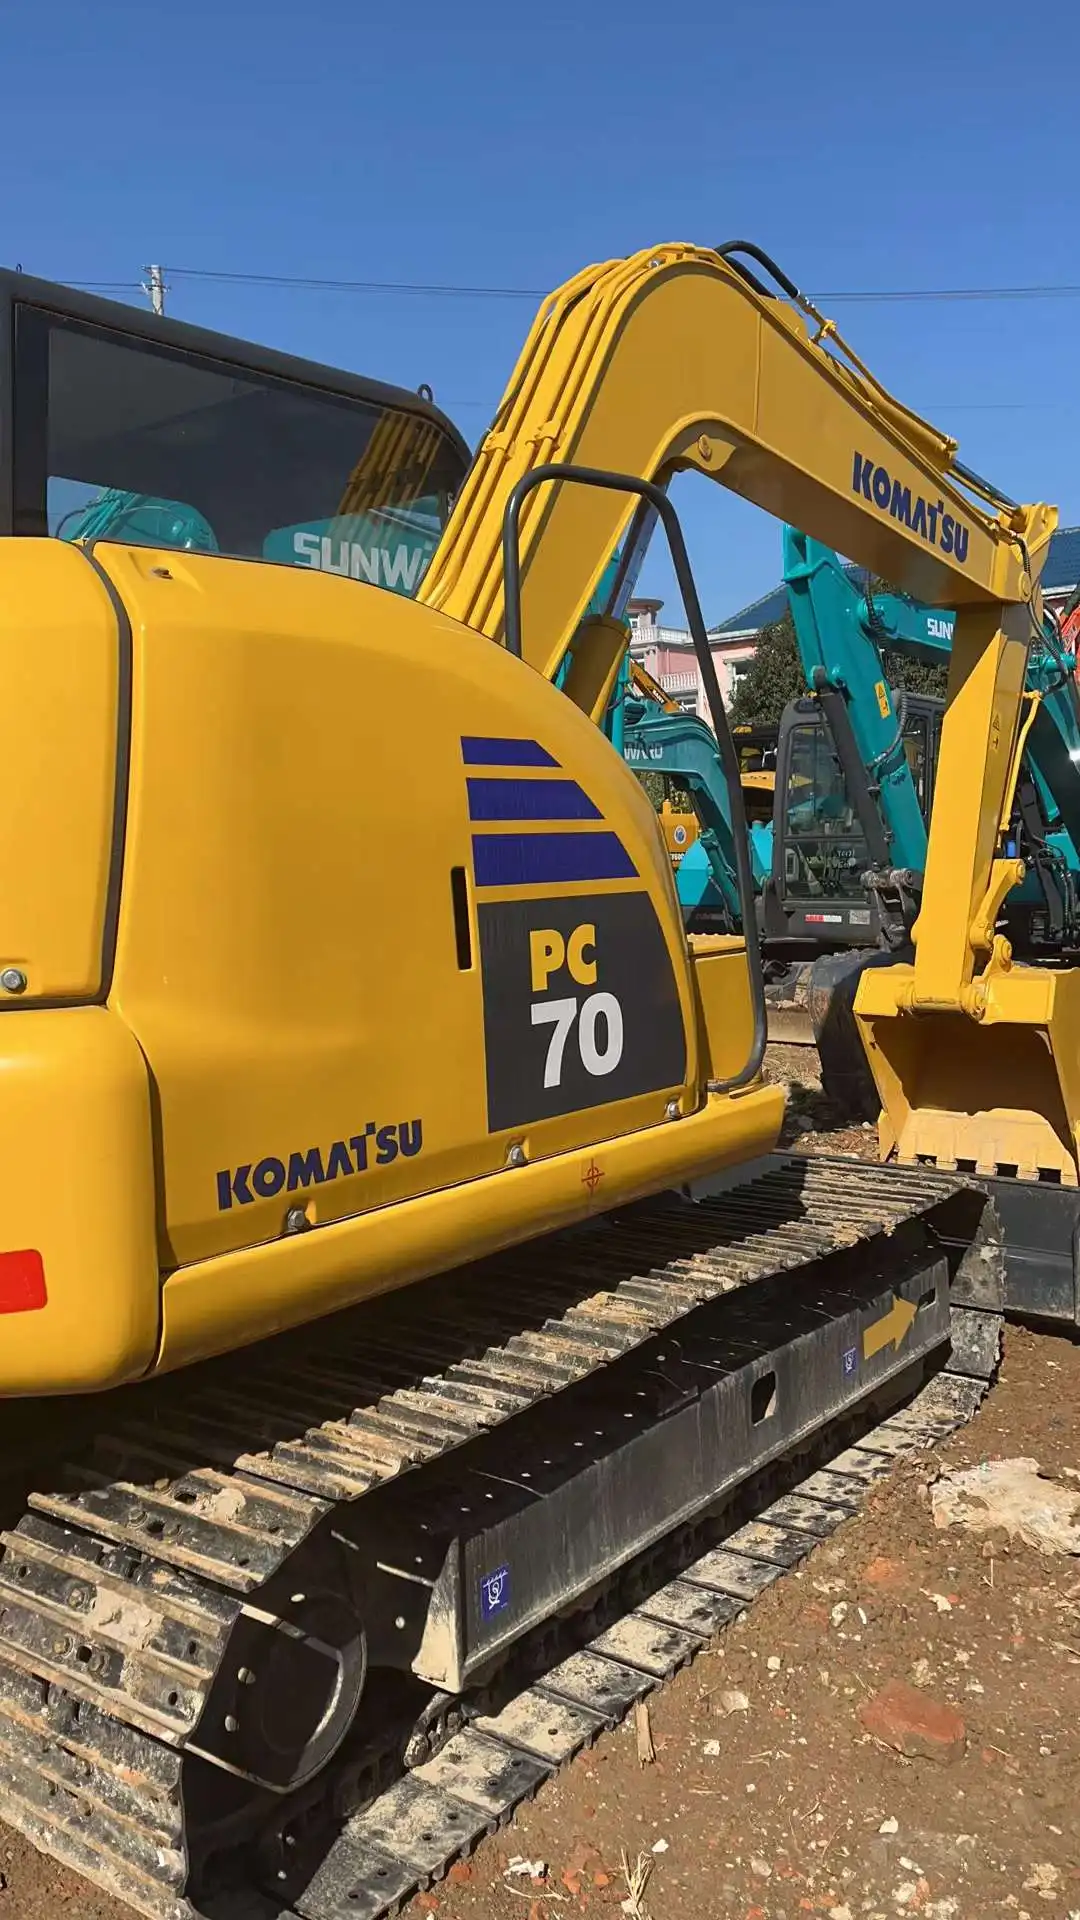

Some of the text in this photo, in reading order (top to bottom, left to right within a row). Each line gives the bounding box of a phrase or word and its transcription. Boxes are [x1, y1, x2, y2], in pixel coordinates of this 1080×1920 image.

[852, 450, 969, 563] KOMATSU
[293, 532, 431, 591] SUNW
[927, 617, 954, 640] SUN
[529, 923, 598, 992] PC
[530, 992, 624, 1089] 70
[216, 1119, 423, 1211] KOMATSU
